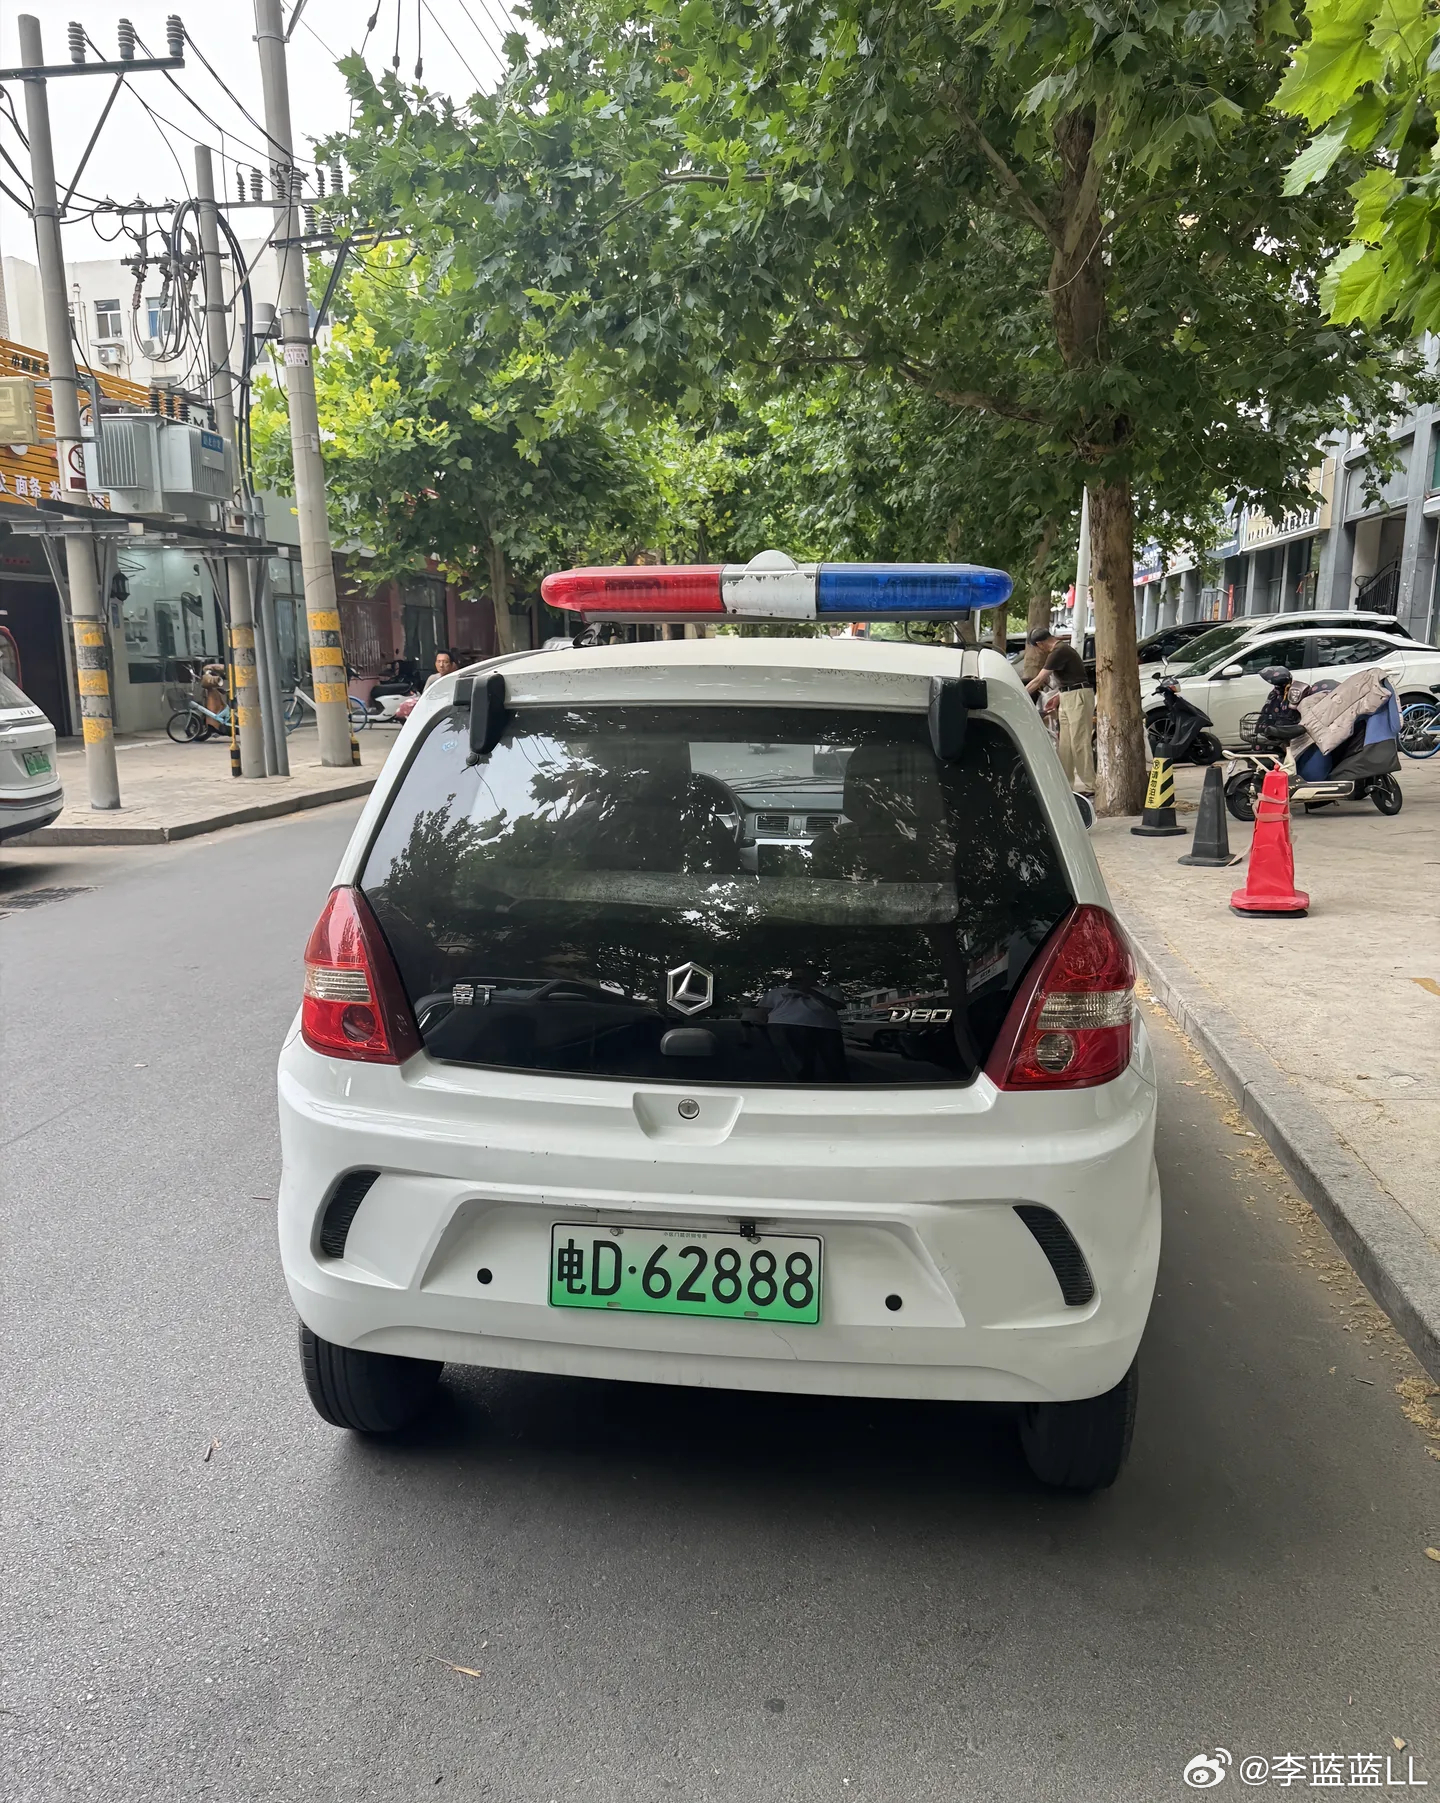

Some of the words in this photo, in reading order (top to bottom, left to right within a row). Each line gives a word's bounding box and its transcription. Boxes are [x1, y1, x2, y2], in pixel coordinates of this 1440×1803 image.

[14, 474, 42, 498] 面条
[1147, 770, 1159, 804] 请勿泊车
[887, 1006, 953, 1023] D80
[557, 1238, 814, 1309] 电D·62888
